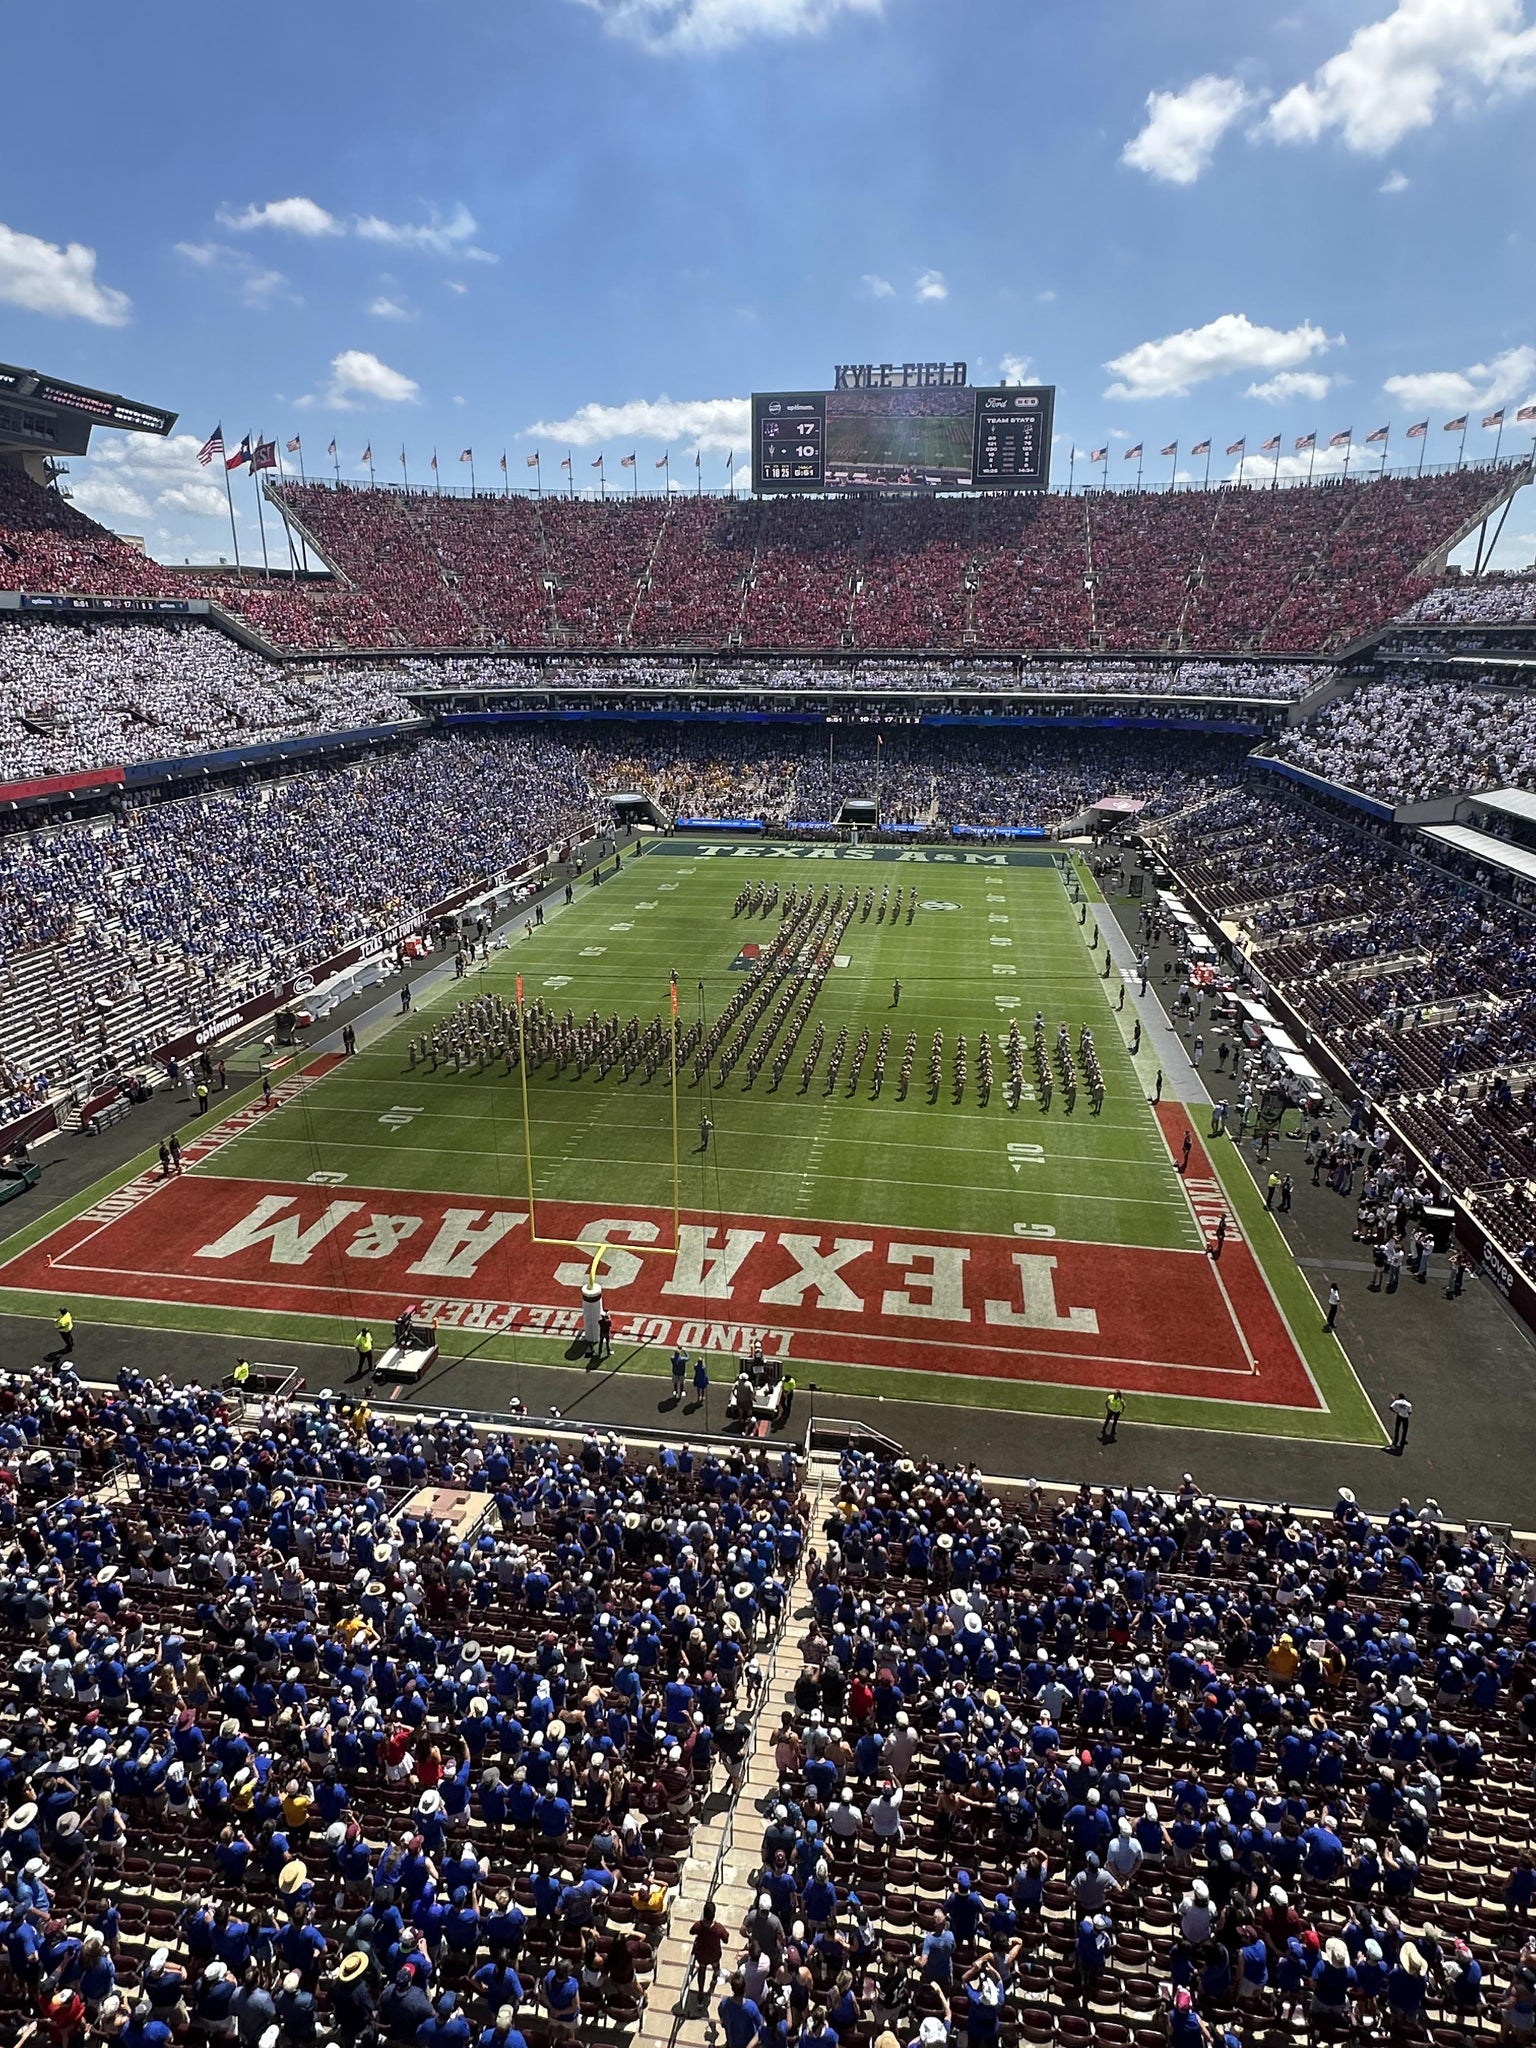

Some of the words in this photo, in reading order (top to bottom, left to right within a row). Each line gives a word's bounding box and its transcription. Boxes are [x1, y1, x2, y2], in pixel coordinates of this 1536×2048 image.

[834, 364, 893, 389] KYLE
[902, 362, 967, 387] FIELD
[985, 397, 1008, 408] Ford
[796, 423, 815, 435] 17
[795, 445, 815, 457] 10
[765, 468, 769, 477] 1
[772, 468, 780, 478] 10
[781, 468, 790, 478] 25
[697, 845, 875, 860] TEXAS
[896, 851, 1009, 865] A&M
[360, 936, 383, 959] TEXAS
[992, 964, 1017, 975] 50
[995, 995, 1022, 1008] 40
[377, 1105, 424, 1124] 10
[77, 1176, 170, 1223] HOME
[186, 1124, 245, 1152] THE
[270, 1074, 320, 1099] MAN
[1007, 1142, 1046, 1164] 10
[307, 1170, 349, 1184] G
[193, 1194, 530, 1278] A&M
[1013, 1222, 1056, 1238] G
[1483, 1241, 1514, 1287] Govee
[553, 1218, 1100, 1334] TEXAS
[411, 1299, 522, 1331] FREE
[613, 1316, 673, 1344] OF
[676, 1321, 795, 1356] LAND
[1010, 1812, 1018, 1823] 5
